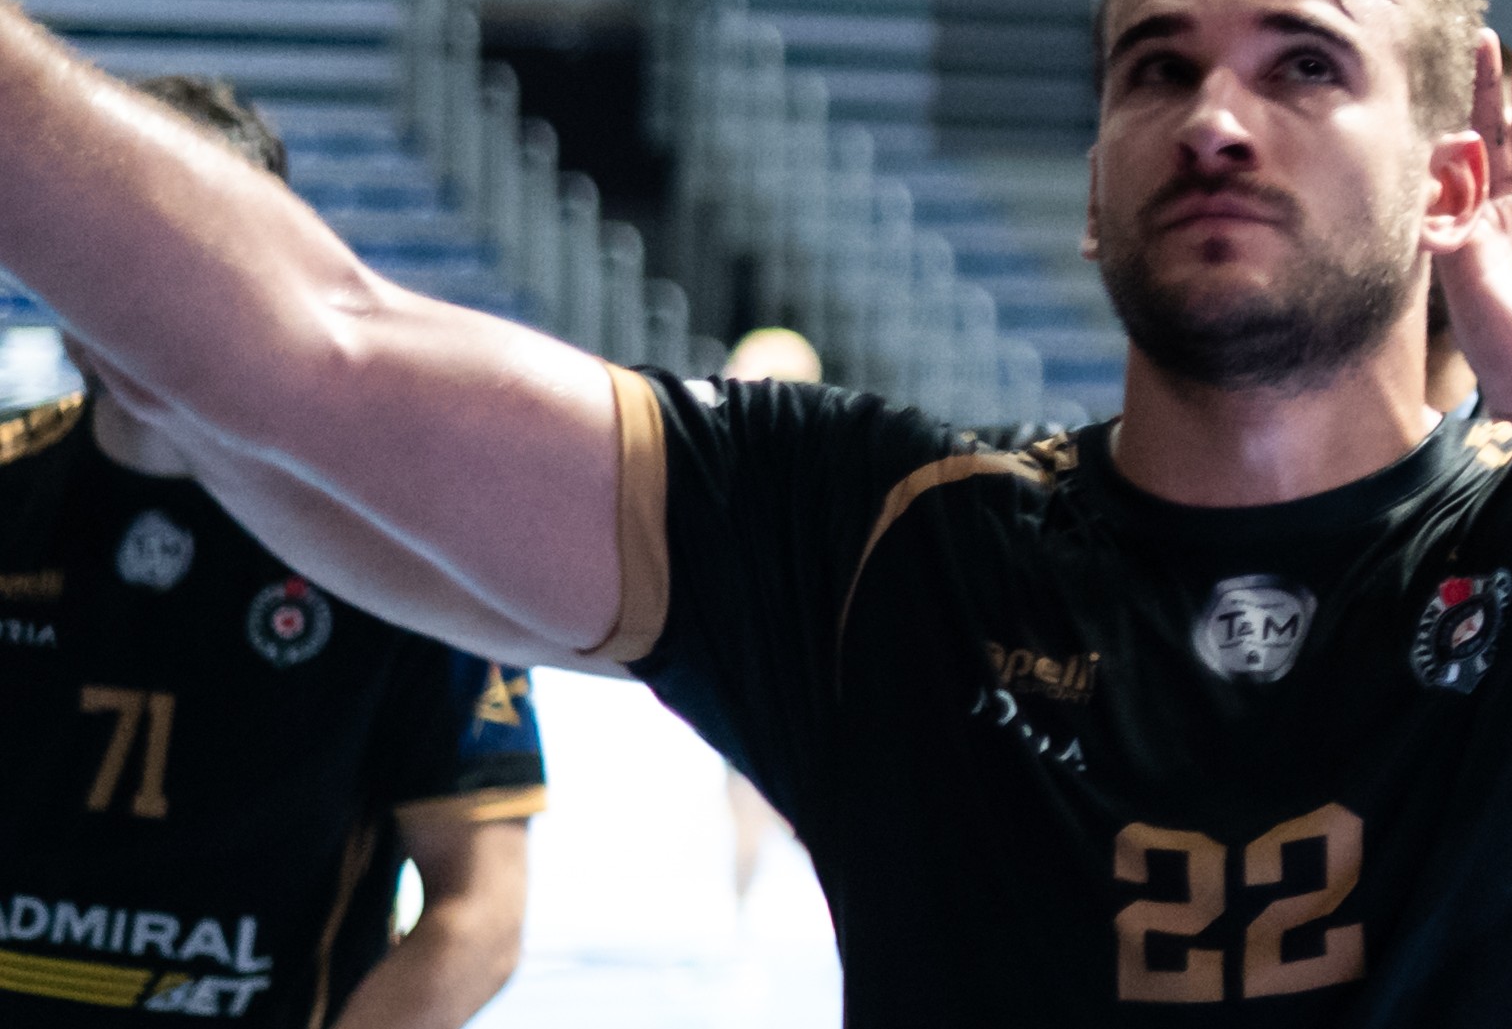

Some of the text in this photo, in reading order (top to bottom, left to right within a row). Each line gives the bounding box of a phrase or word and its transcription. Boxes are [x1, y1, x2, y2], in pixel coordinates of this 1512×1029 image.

[1218, 610, 1299, 640] T&M
[81, 686, 175, 818] 71
[0, 893, 273, 973] DMIRAL
[1113, 802, 1365, 1003] 22
